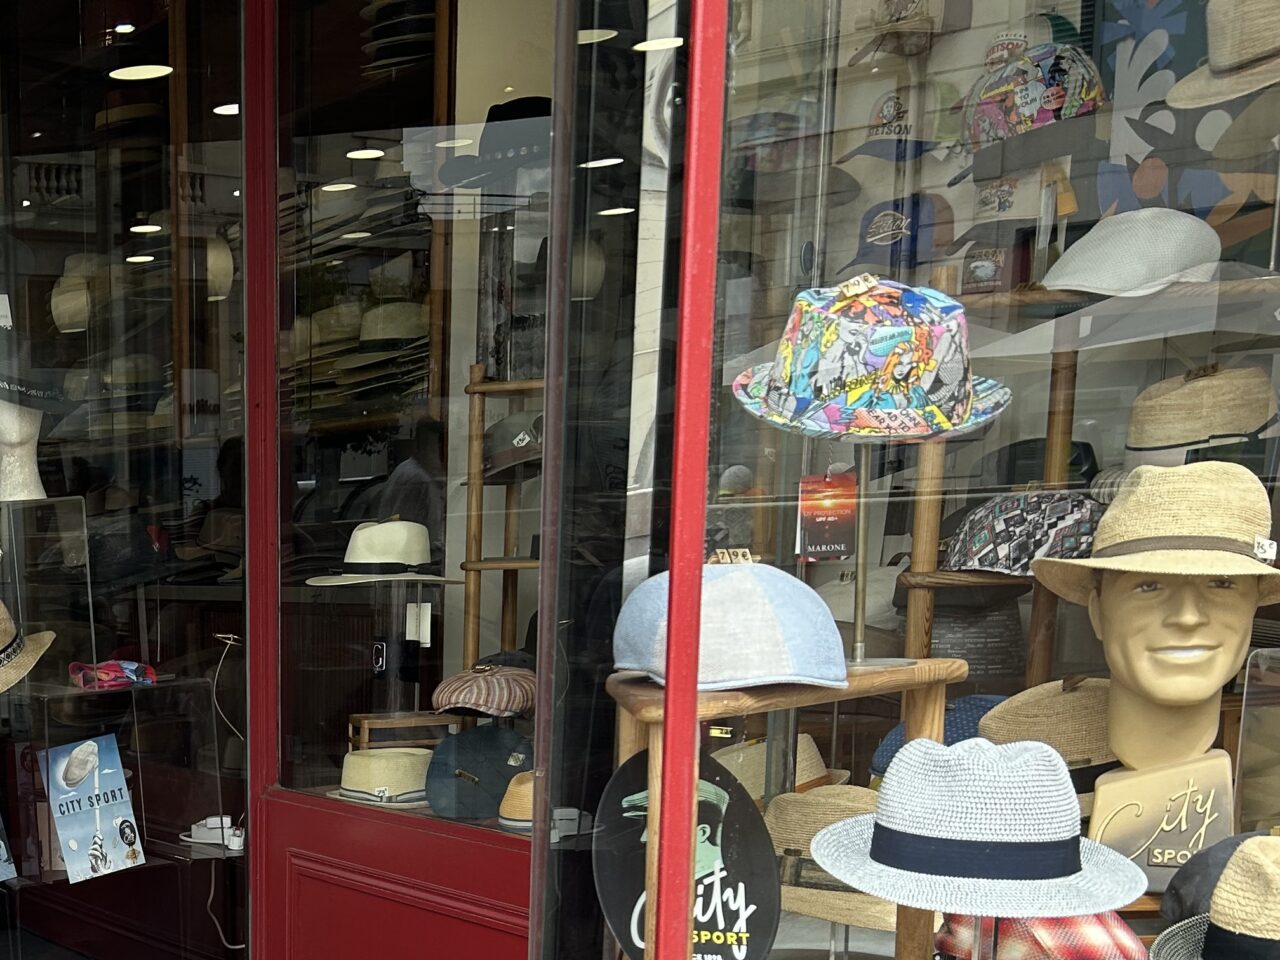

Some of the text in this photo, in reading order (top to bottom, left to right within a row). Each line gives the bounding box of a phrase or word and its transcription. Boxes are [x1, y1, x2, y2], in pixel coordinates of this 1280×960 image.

[719, 550, 749, 560] 79€
[807, 544, 847, 552] MARONE
[58, 787, 126, 816] CITY SPORT
[1096, 778, 1219, 861] City
